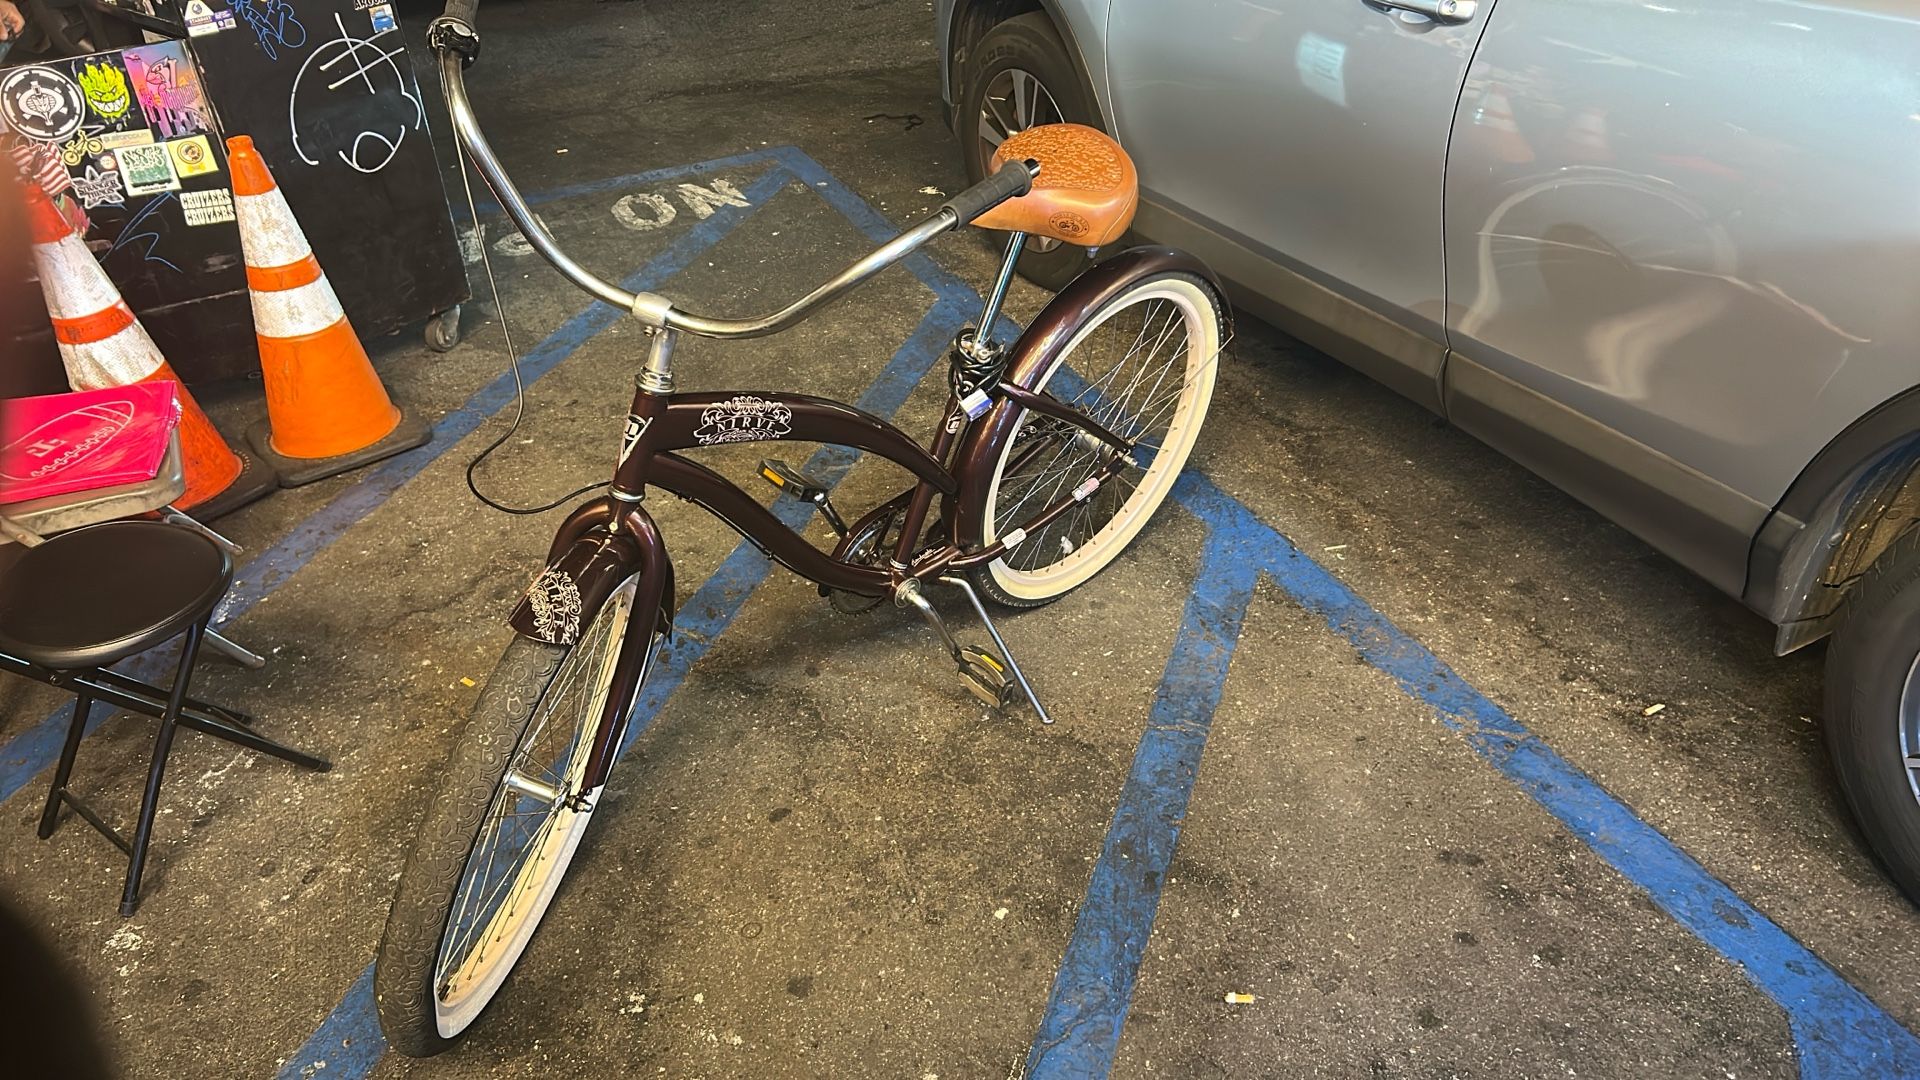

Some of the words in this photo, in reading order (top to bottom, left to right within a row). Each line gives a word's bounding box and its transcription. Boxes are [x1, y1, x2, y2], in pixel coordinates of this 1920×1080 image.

[78, 180, 119, 196] STRANGER
[86, 187, 115, 199] THINGS
[180, 188, 232, 209] CRUIZERS
[184, 204, 235, 226] CRUIZERS
[716, 416, 776, 433] NIRVE
[542, 577, 565, 628] NIRVE
